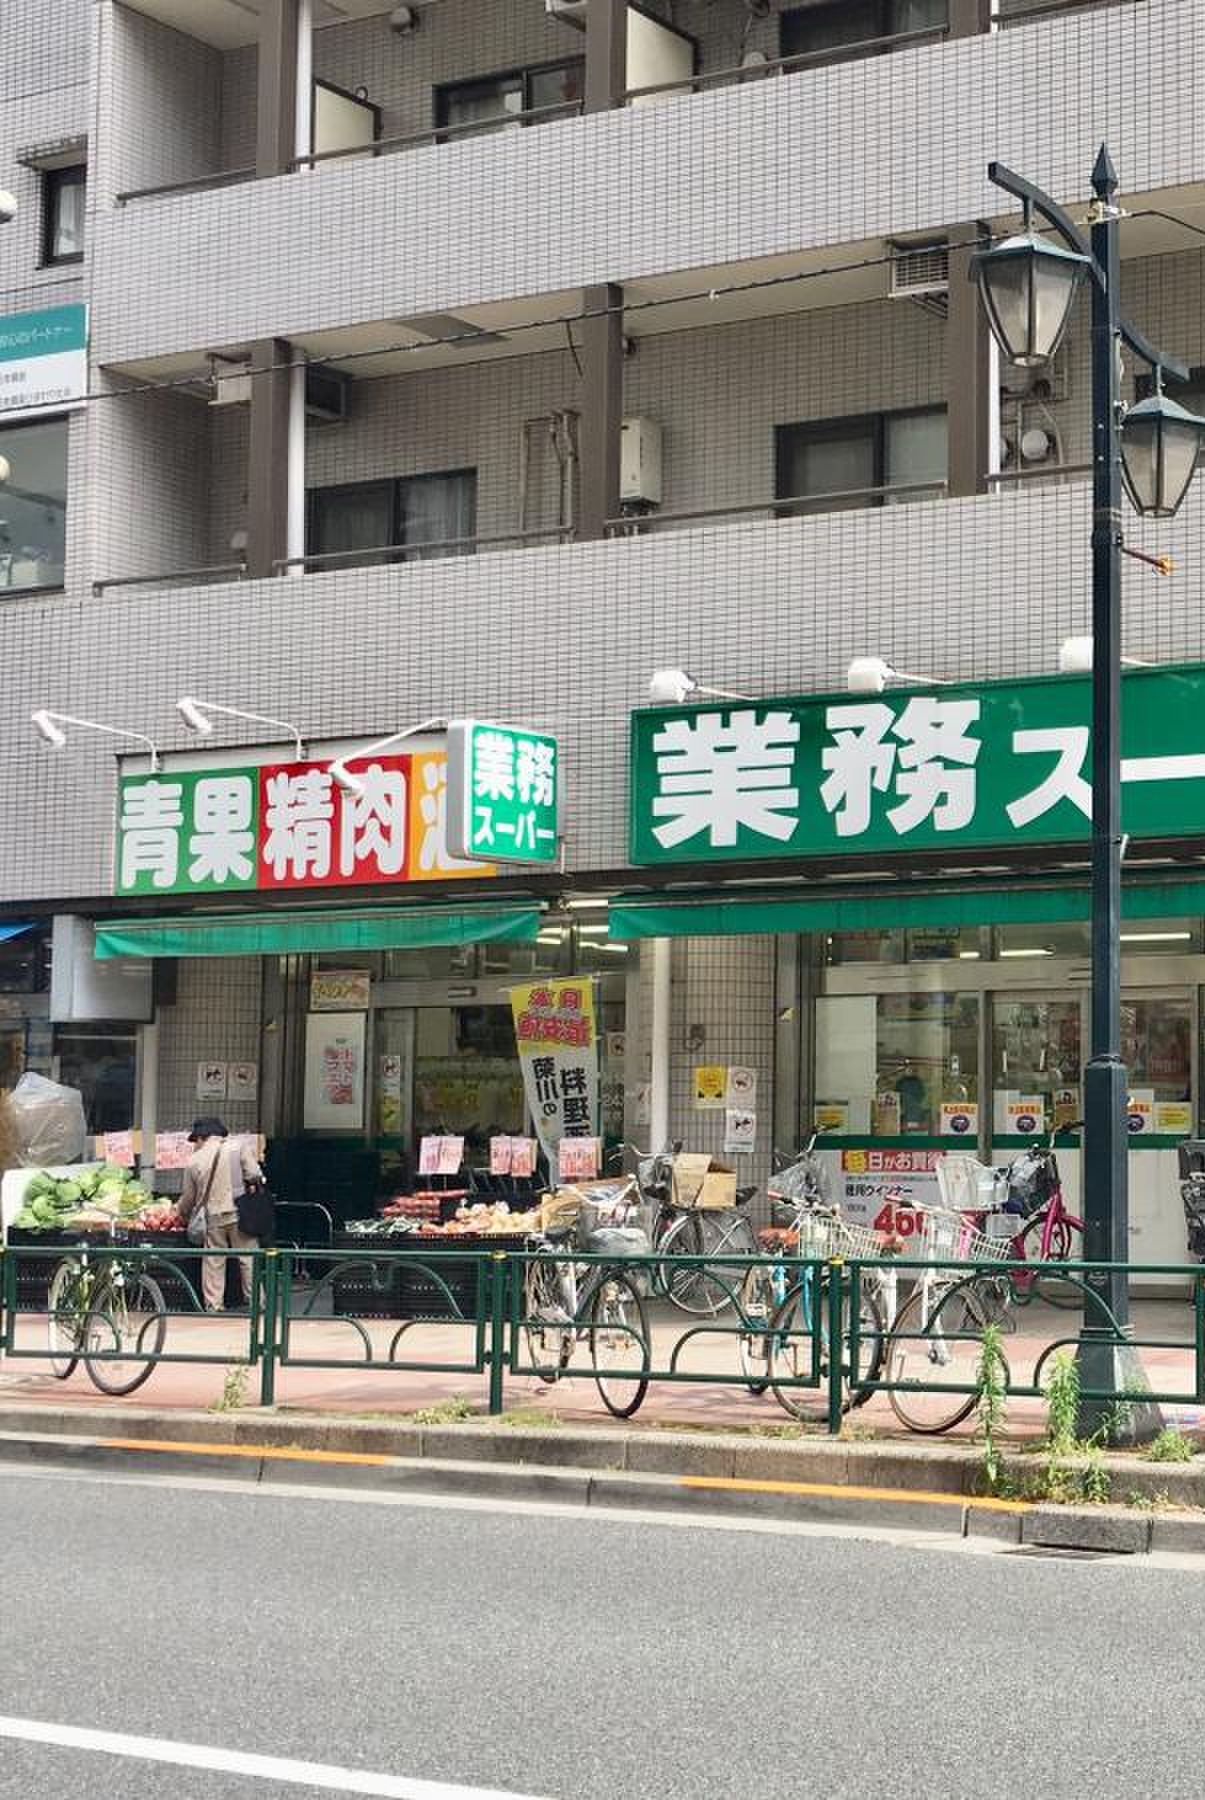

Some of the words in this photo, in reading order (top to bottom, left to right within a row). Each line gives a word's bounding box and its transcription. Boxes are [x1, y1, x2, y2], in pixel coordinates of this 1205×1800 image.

[474, 732, 556, 807] 業務
[474, 806, 555, 850] スーパー
